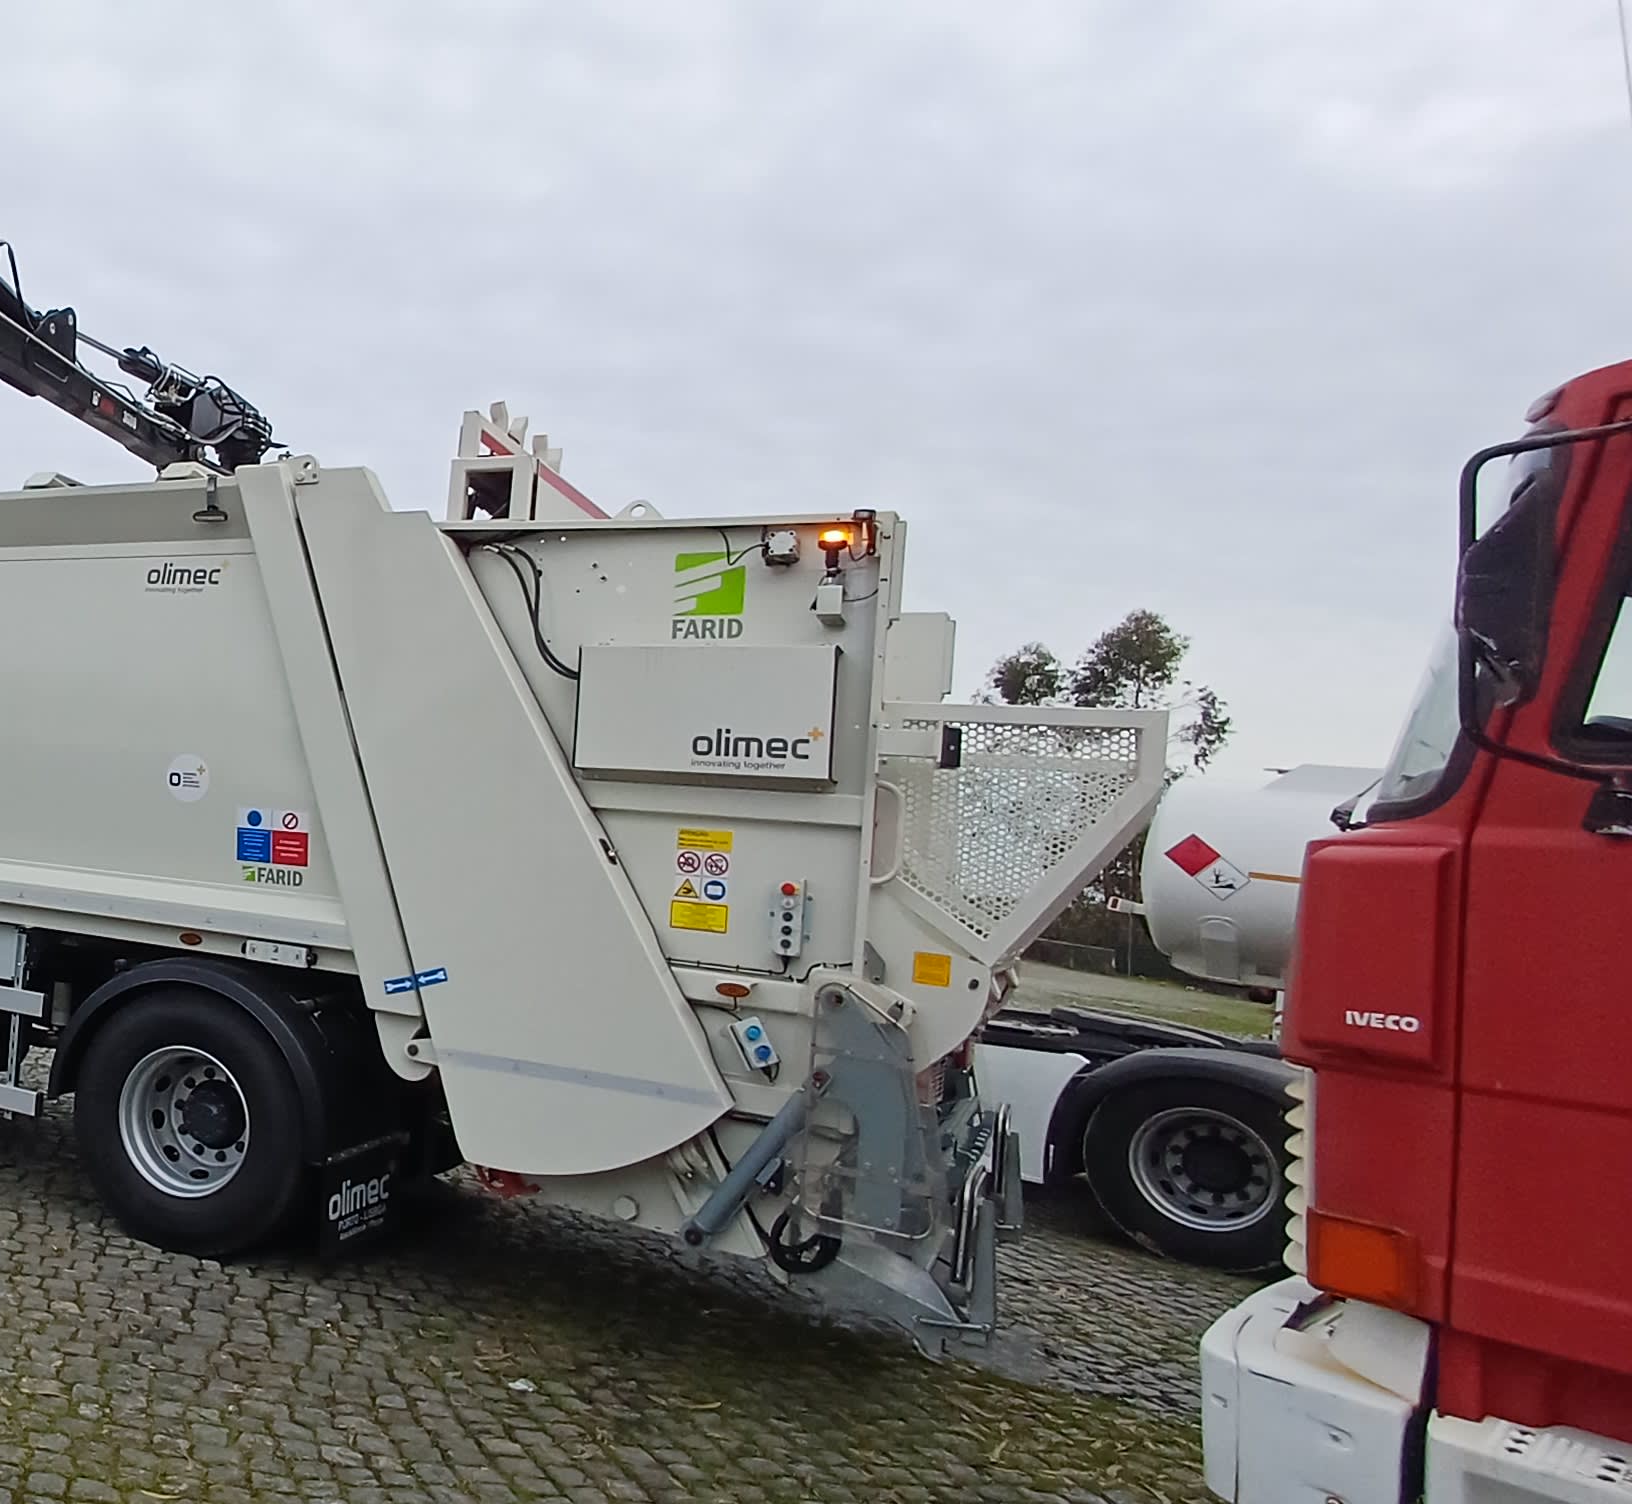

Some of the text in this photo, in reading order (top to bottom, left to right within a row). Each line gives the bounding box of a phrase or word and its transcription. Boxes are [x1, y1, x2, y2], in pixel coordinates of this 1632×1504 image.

[147, 562, 221, 585] olimec
[671, 617, 743, 640] FARID
[691, 728, 811, 760] olimec
[690, 758, 786, 771] innovating together
[257, 866, 303, 887] FARID
[1345, 1010, 1420, 1033] IVECO
[328, 1173, 390, 1221] olimec
